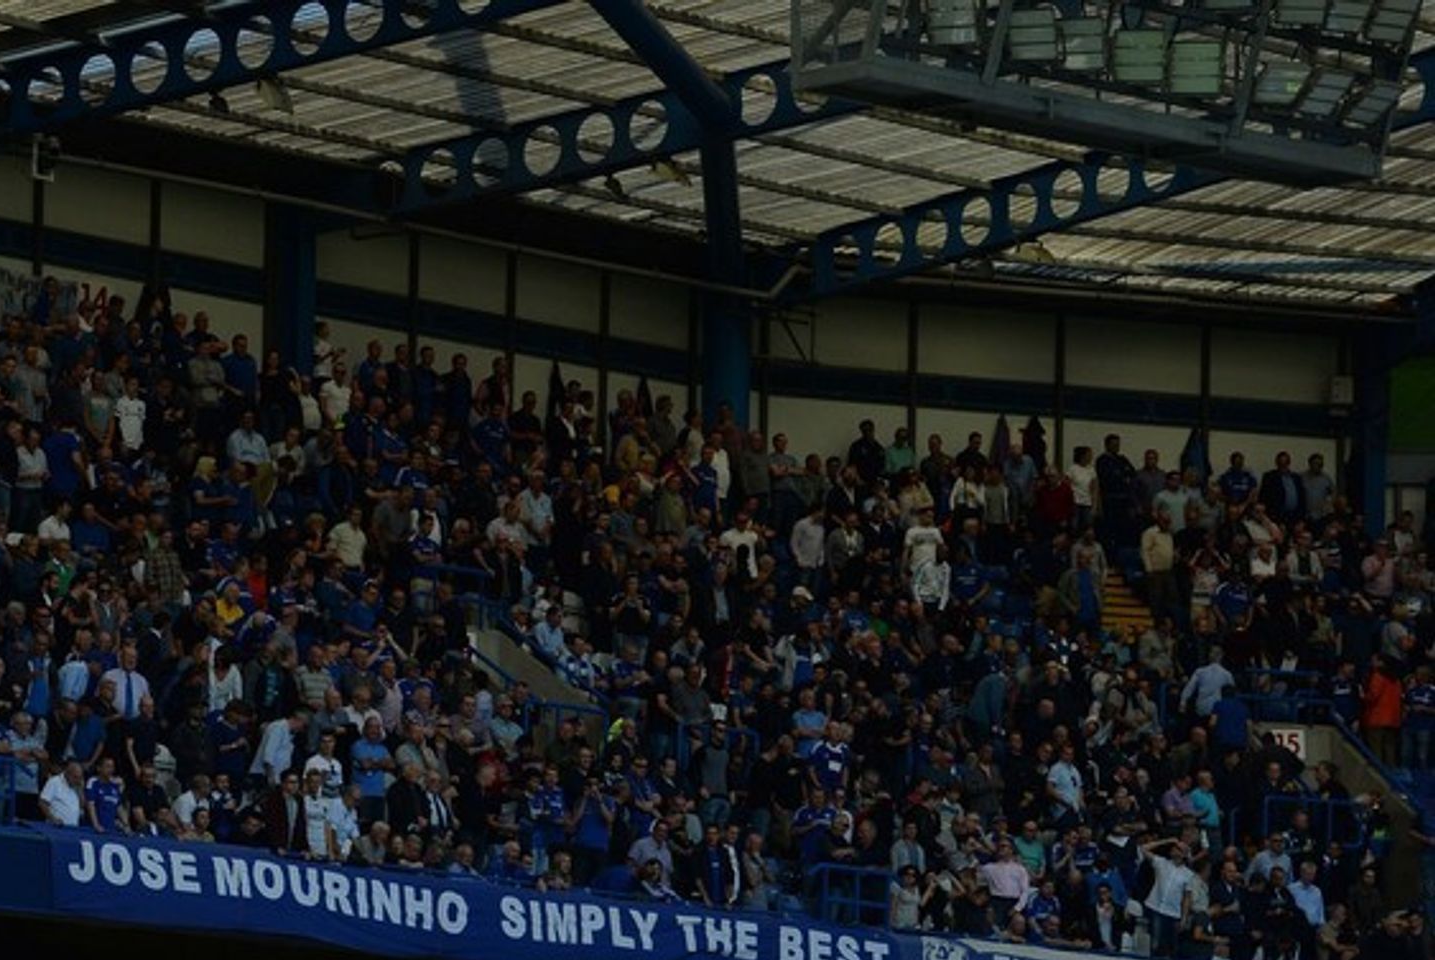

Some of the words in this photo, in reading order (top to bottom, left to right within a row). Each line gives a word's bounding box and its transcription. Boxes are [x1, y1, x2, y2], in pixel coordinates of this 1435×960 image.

[68, 840, 202, 893] JOSE
[211, 856, 469, 935] MOURINHO
[499, 895, 659, 950] SIMPLY
[675, 914, 759, 960] THE
